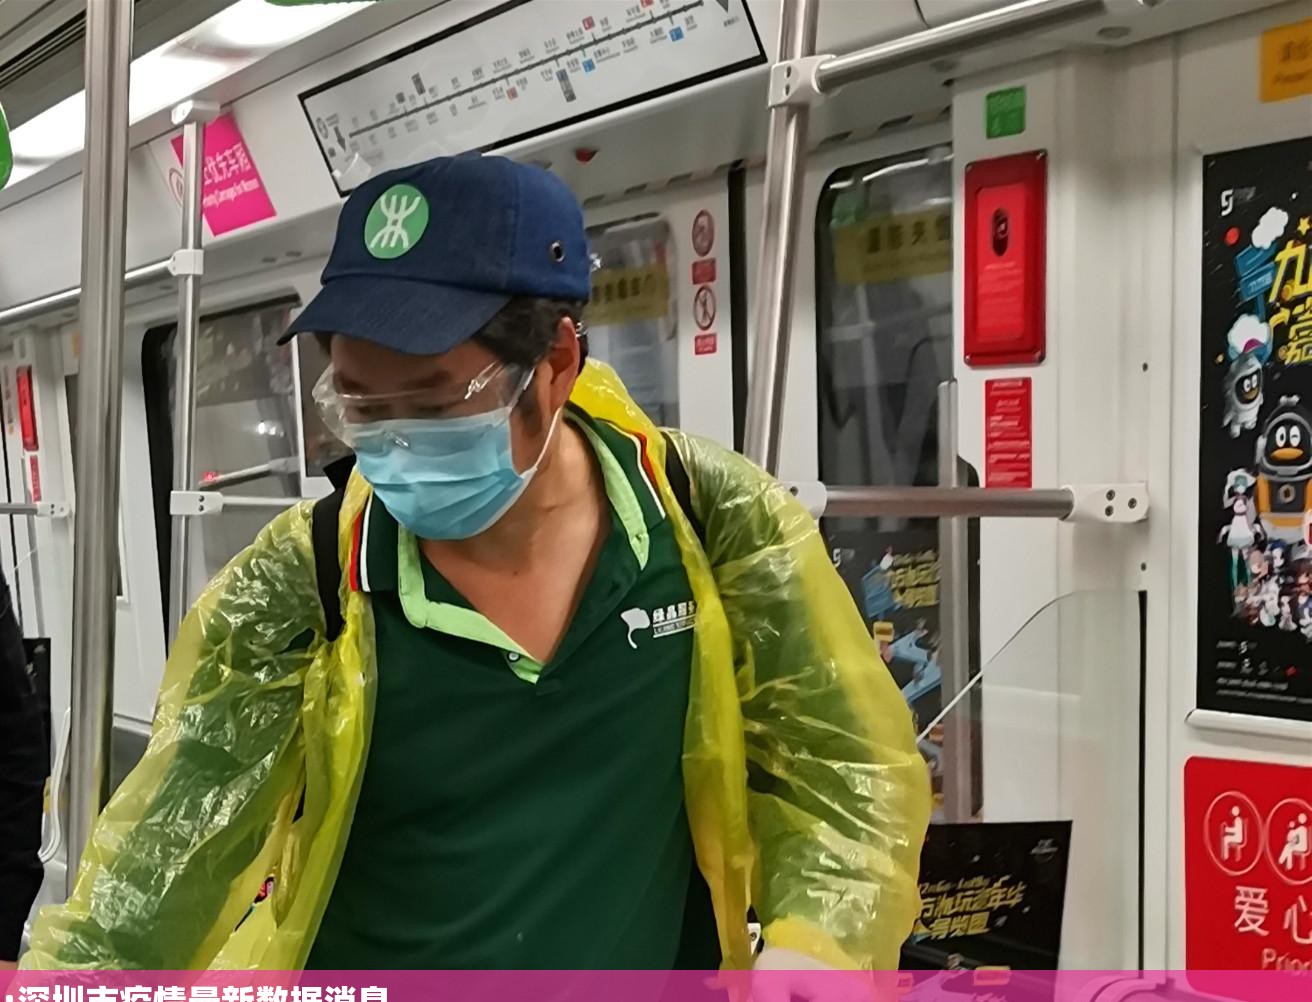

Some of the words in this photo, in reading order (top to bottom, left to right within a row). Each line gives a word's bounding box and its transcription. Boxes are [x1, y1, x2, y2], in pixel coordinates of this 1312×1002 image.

[921, 874, 1027, 918] 方潮玩嘉年华
